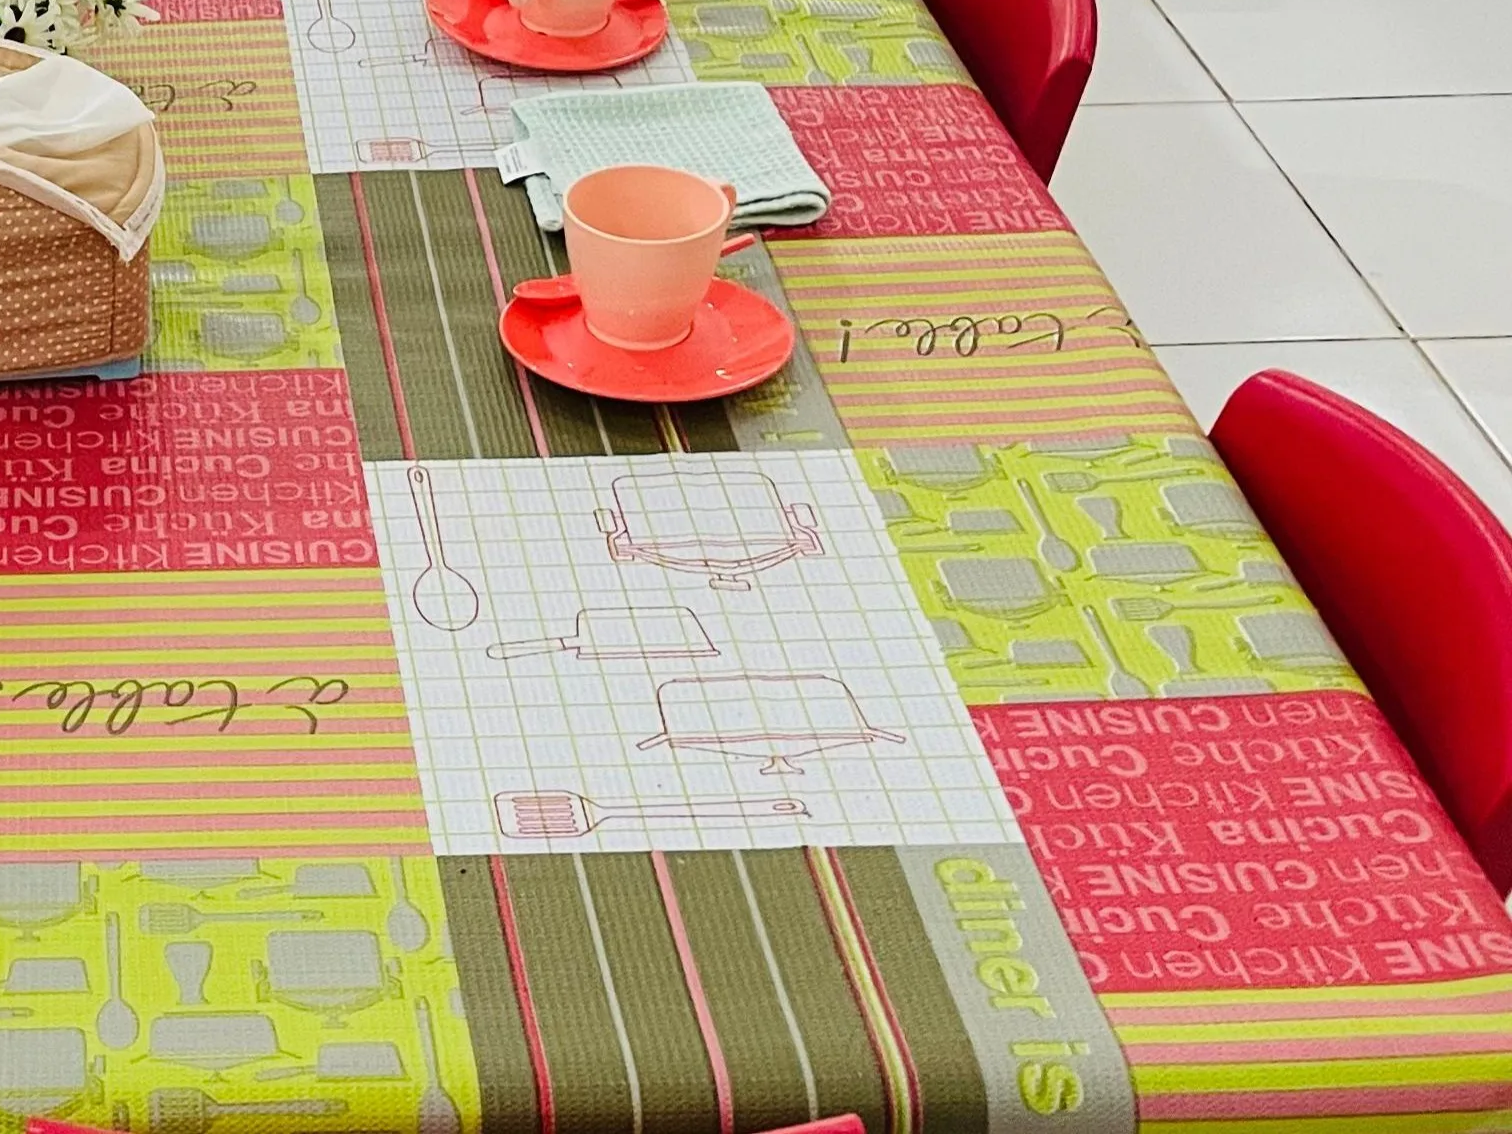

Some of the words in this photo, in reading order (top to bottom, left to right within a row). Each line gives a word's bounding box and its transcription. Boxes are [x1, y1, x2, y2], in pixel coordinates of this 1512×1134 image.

[161, 372, 343, 399] Kitchen
[174, 424, 353, 449] CUISINE
[100, 453, 271, 479] Cucina
[177, 479, 361, 507] Kitchen
[91, 509, 276, 540] Küche
[182, 538, 374, 568] CUISINE
[1012, 703, 1232, 737] CUISINE
[1170, 733, 1386, 775] Küche
[1045, 779, 1276, 815] Kitchen
[1207, 807, 1434, 853] Cucina
[1076, 859, 1319, 897] CUISINE
[1251, 888, 1487, 939] Küche
[1120, 945, 1370, 985] Kitchen
[933, 857, 1057, 1019] diner
[1009, 1040, 1091, 1115] is
